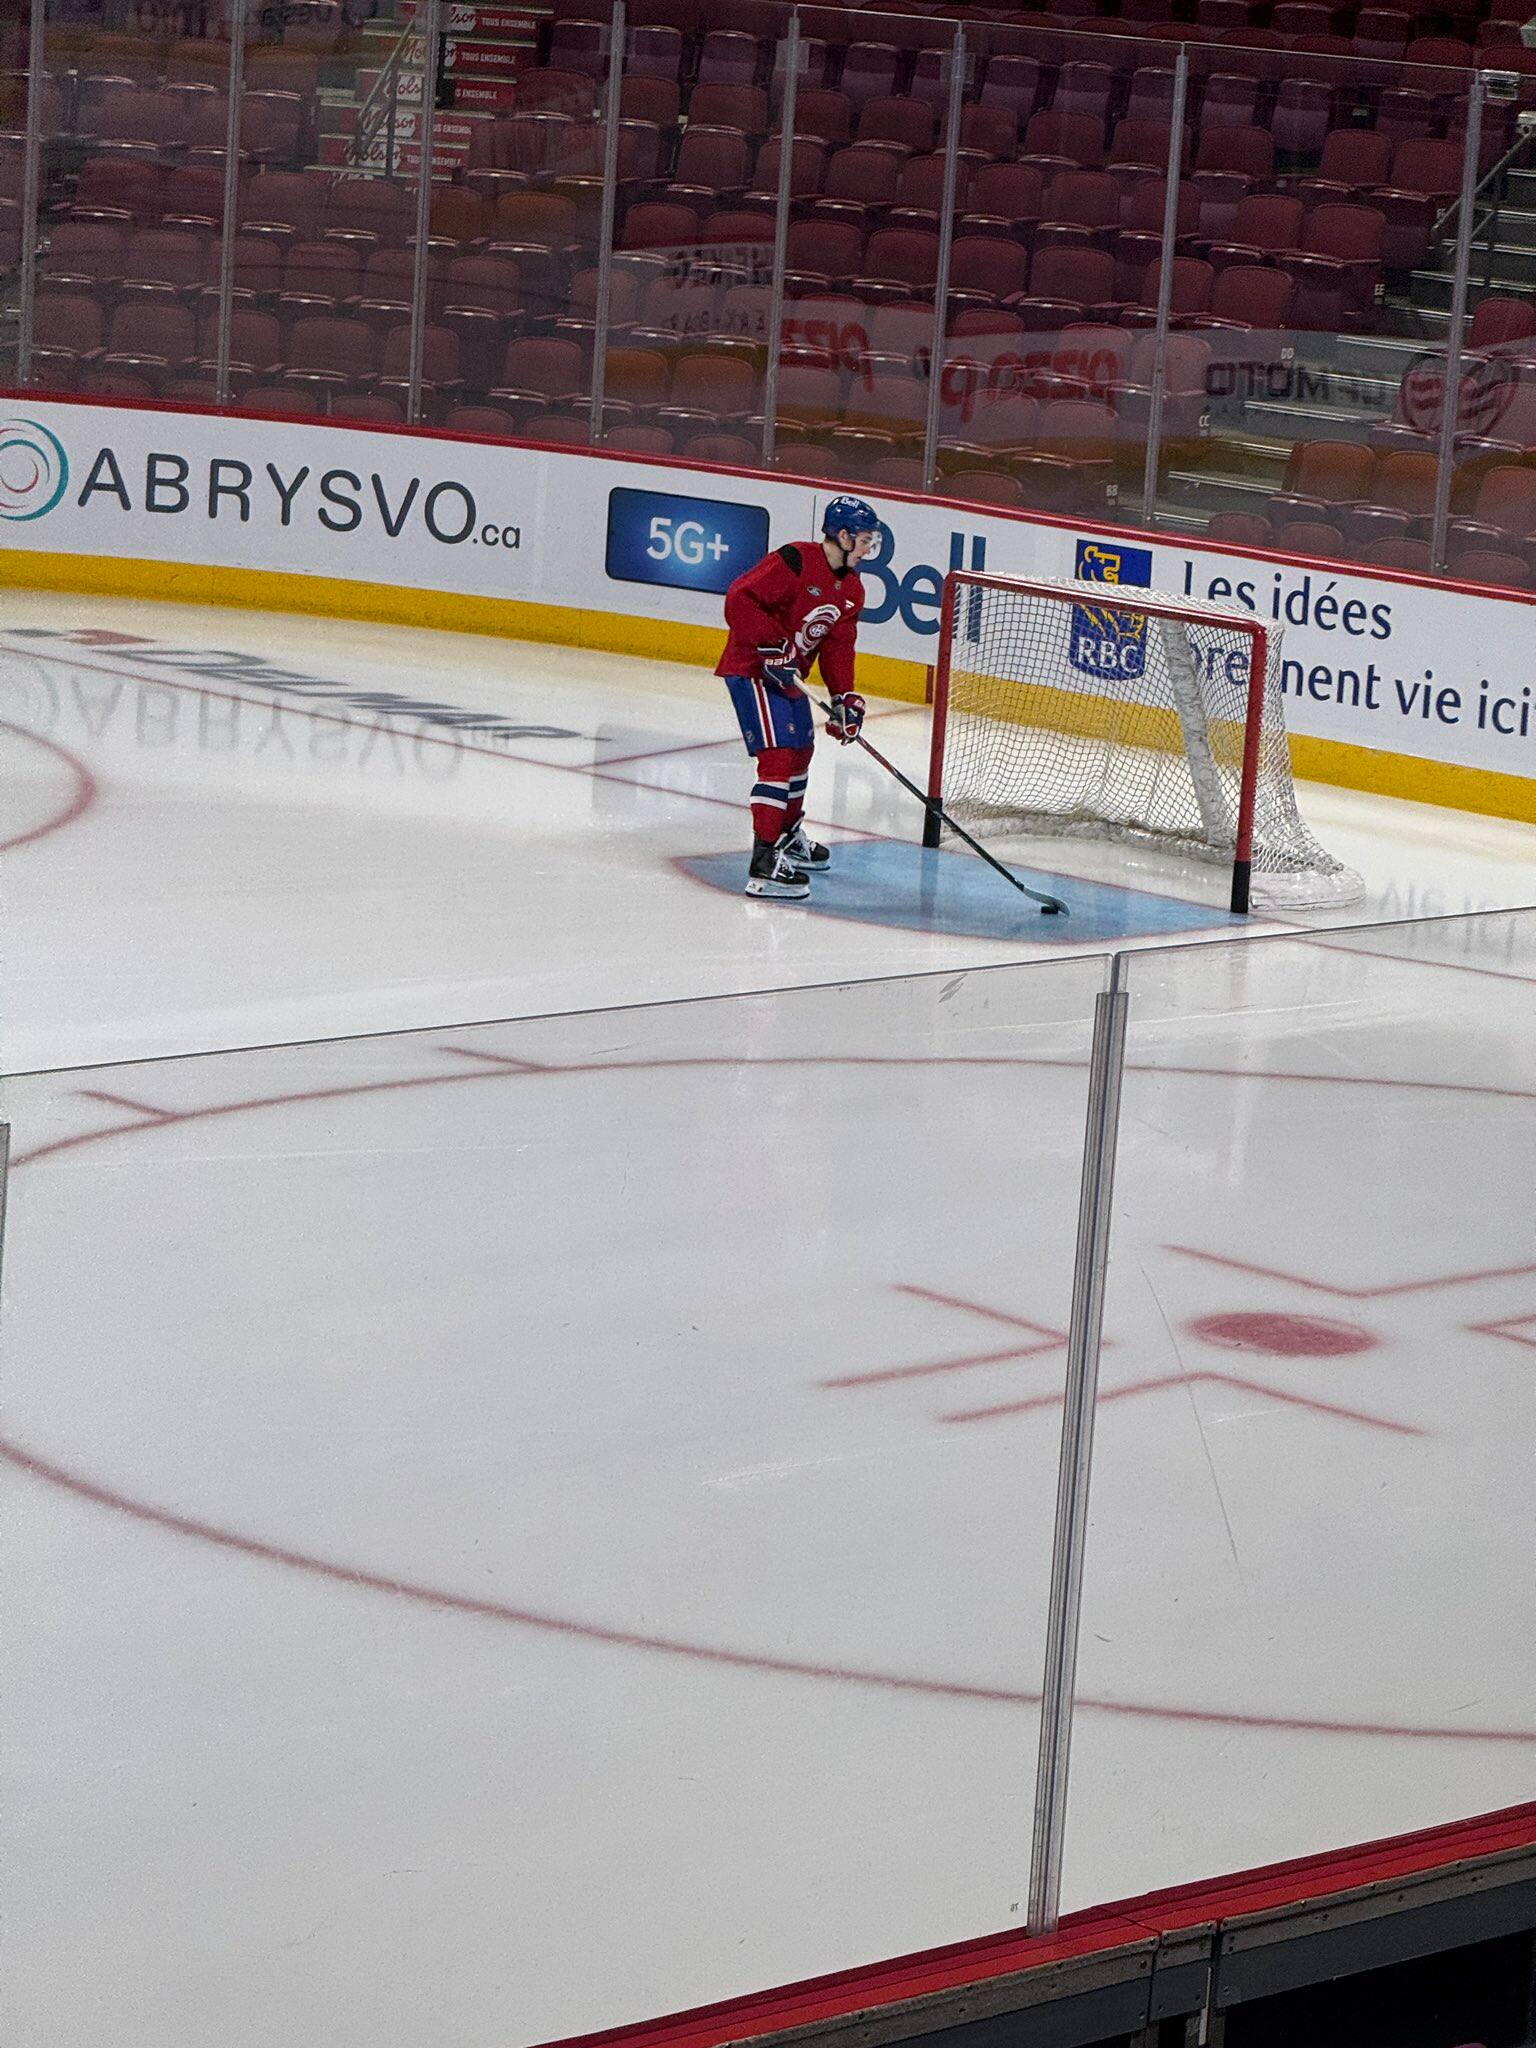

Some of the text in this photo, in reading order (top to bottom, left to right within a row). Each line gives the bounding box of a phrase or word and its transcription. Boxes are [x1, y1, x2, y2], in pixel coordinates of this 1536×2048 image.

[481, 17, 537, 30] TOUS ENSEMBLE
[461, 51, 516, 65] TOUS ENSEMBLE
[462, 89, 498, 100] ENSEMBLE
[1374, 283, 1386, 296] EE
[77, 447, 522, 550] ABRYSVO.ca
[840, 496, 859, 510] Bell
[646, 516, 730, 565] 5G+
[1271, 572, 1394, 640] idées
[1077, 636, 1140, 674] RBC
[1395, 669, 1462, 725] vie
[1477, 679, 1531, 737] ici
